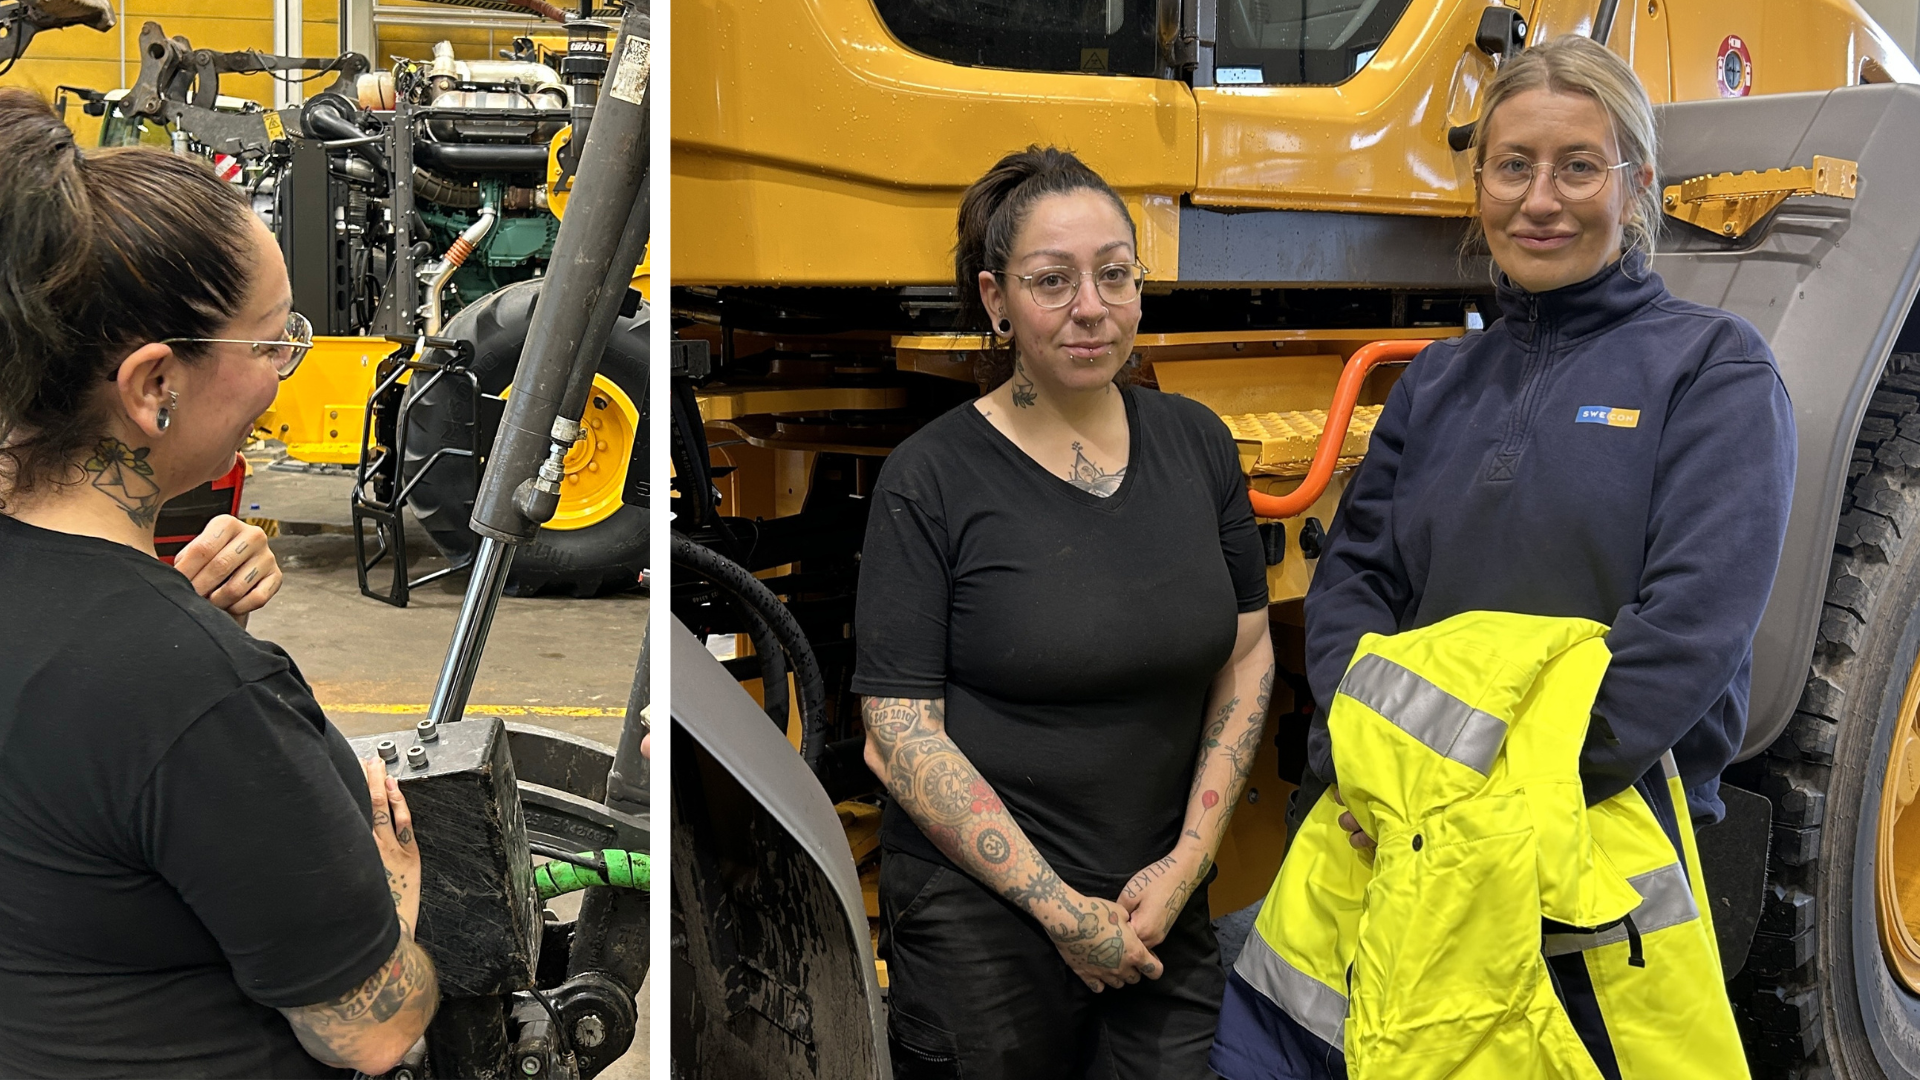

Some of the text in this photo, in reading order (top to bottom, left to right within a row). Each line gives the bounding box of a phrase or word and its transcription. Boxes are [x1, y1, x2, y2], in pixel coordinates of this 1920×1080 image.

[1582, 410, 1634, 423] SWECON
[890, 708, 912, 722] 2010
[1123, 855, 1177, 899] MELKER
